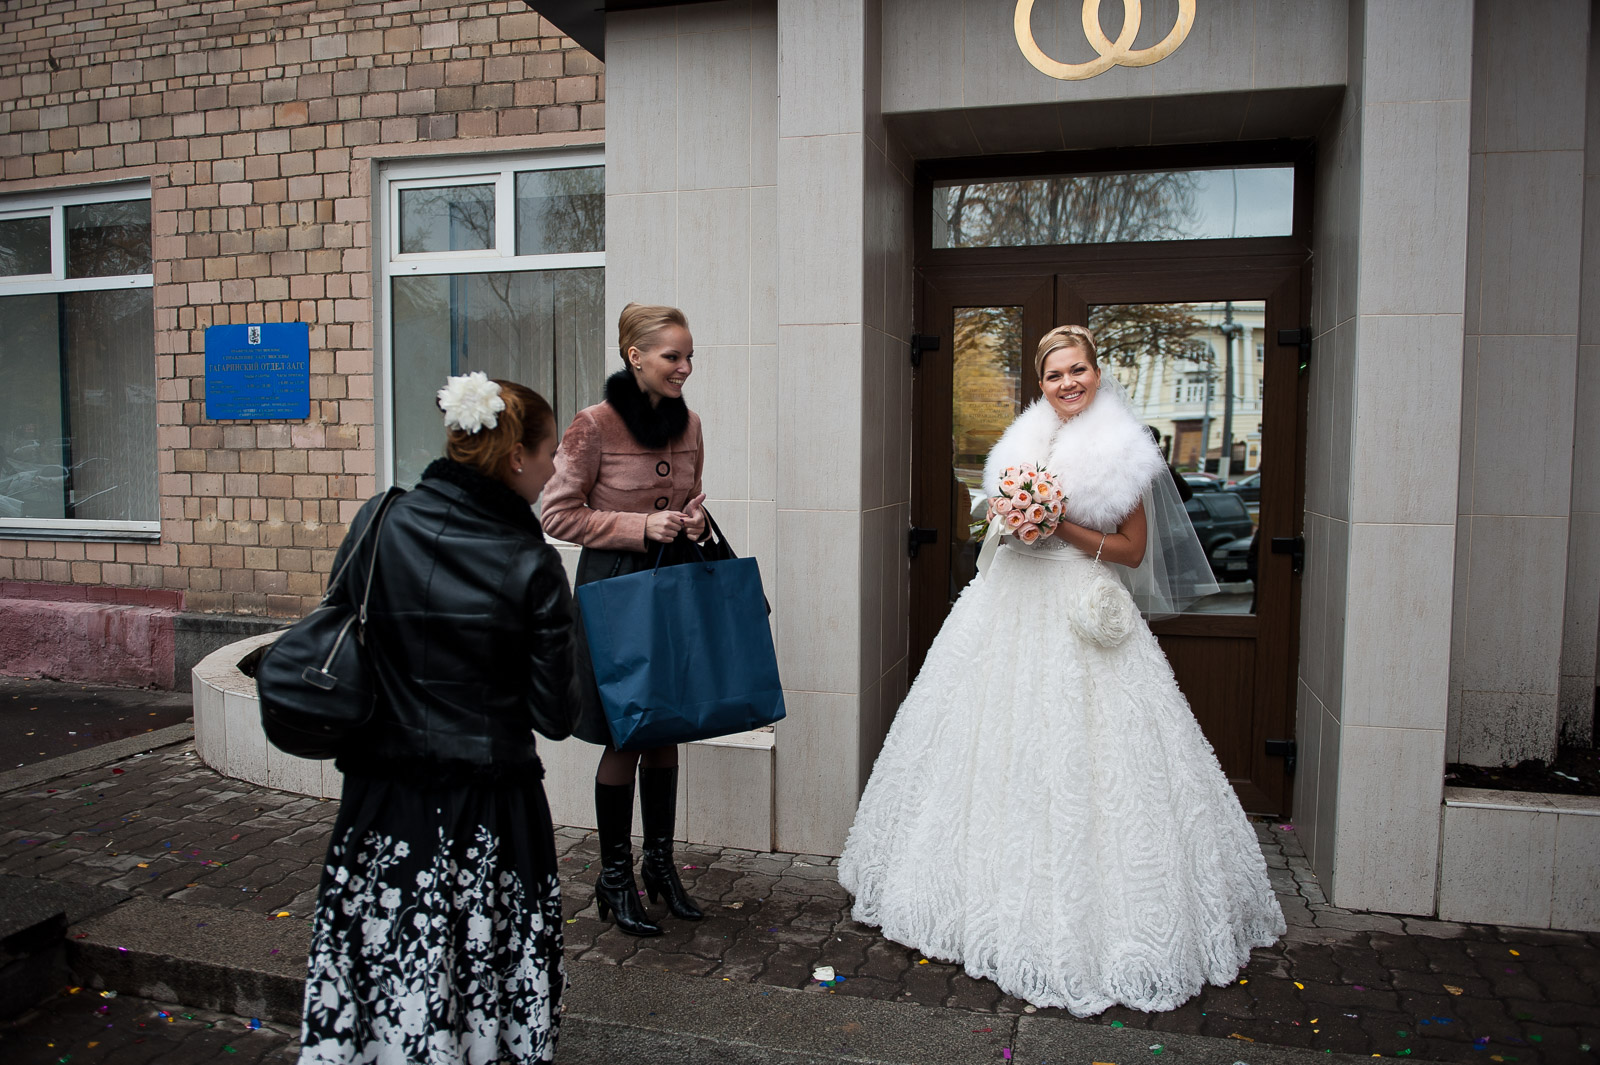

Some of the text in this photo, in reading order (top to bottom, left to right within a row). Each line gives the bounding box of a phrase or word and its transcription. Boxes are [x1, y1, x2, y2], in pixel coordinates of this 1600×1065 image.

[209, 362, 305, 372] ГАГАРИНСКИЙ ОТДЕЛ ЗАГС
